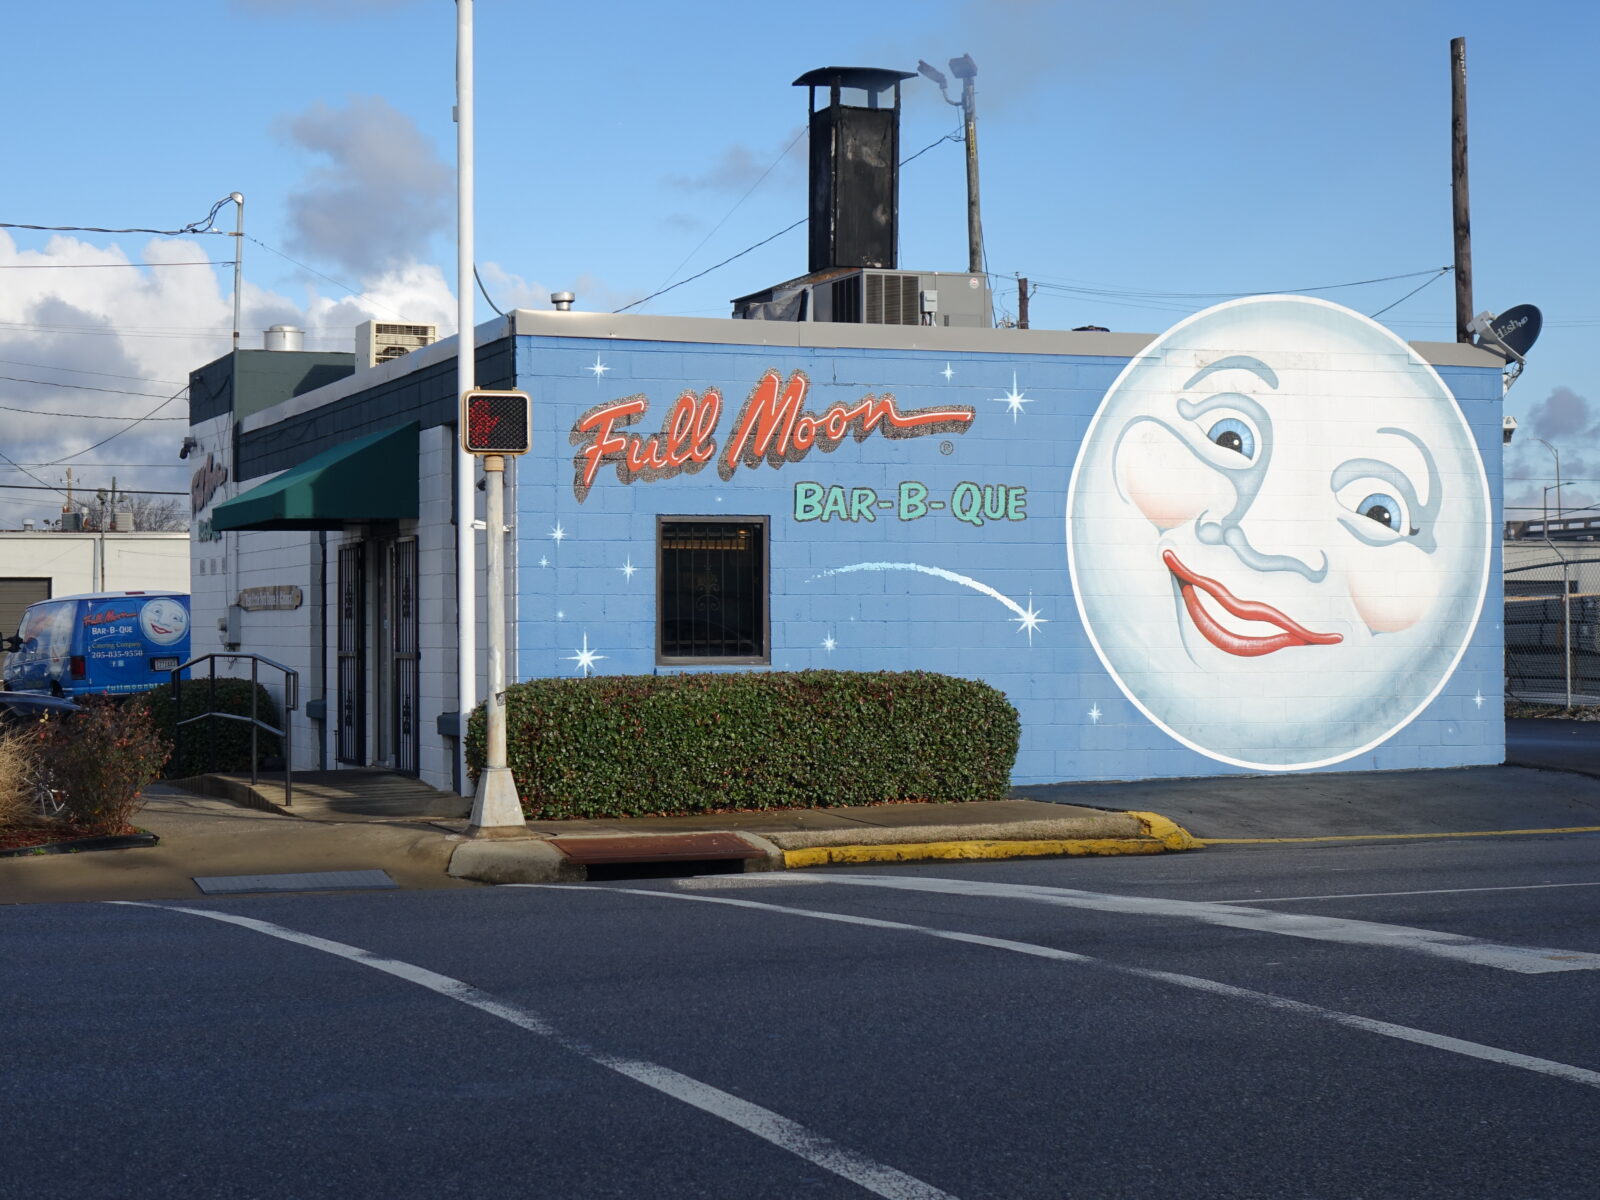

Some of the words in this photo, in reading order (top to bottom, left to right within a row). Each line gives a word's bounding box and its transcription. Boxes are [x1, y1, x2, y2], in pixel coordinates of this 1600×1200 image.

[1496, 319, 1519, 339] dish
[570, 387, 721, 502] Full
[719, 368, 974, 479] Moon
[793, 481, 1027, 526] BAR-B-QUE
[91, 625, 133, 635] BAR-B-QUE
